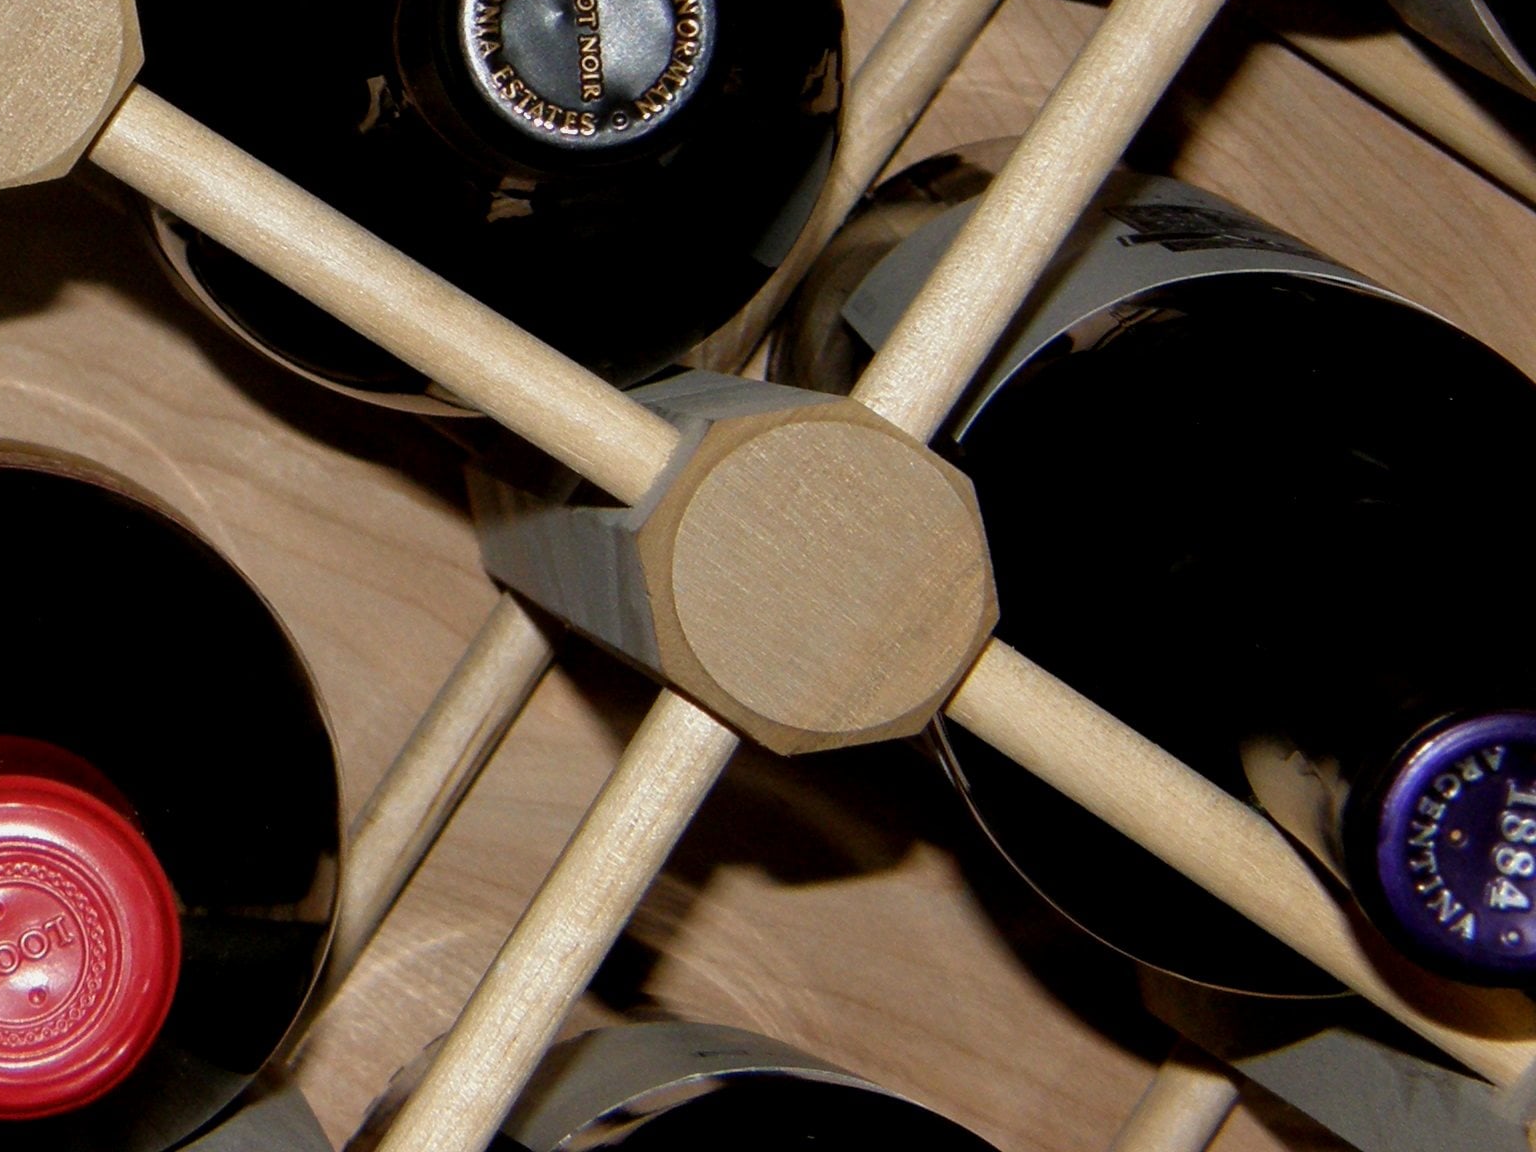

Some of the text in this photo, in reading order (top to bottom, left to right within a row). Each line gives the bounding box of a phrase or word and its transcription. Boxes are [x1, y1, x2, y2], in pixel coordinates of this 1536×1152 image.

[491, 64, 597, 136] ESTATES
[577, 35, 603, 102] NOIR
[1408, 745, 1507, 941] ARGENTINA
[1483, 778, 1536, 910] 1884
